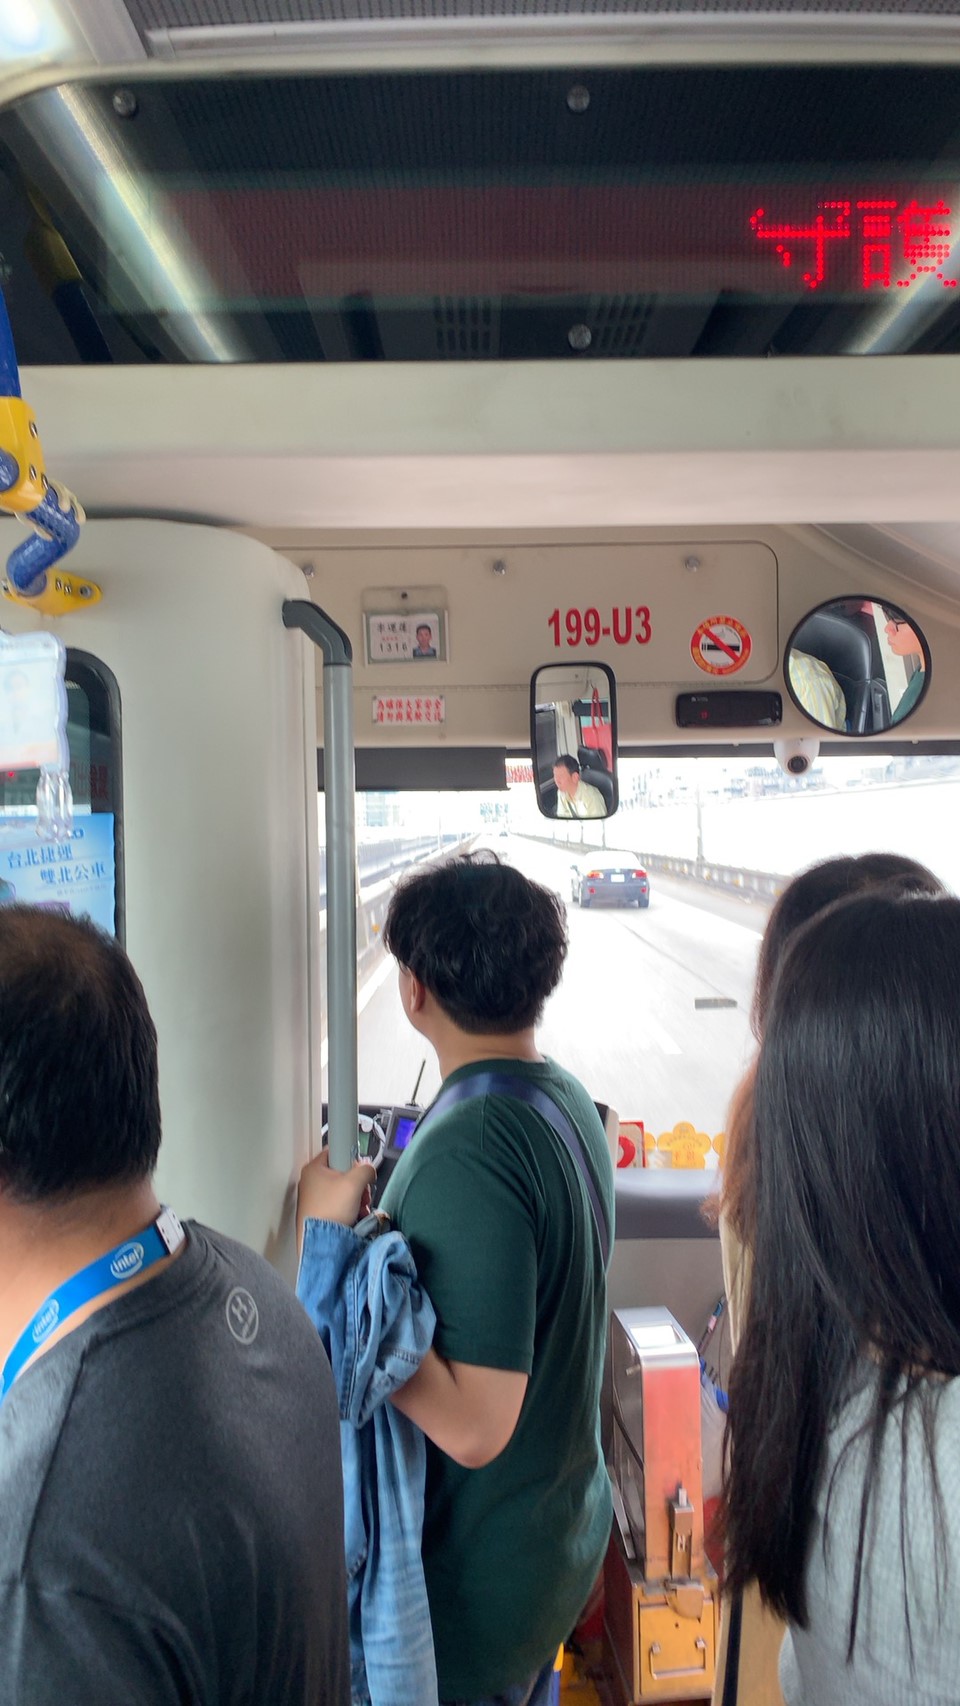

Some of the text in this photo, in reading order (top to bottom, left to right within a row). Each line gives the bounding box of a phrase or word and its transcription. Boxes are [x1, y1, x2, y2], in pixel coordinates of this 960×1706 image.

[548, 606, 652, 647] 199-U3
[112, 1248, 140, 1272] intel
[33, 1306, 57, 1336] intel
